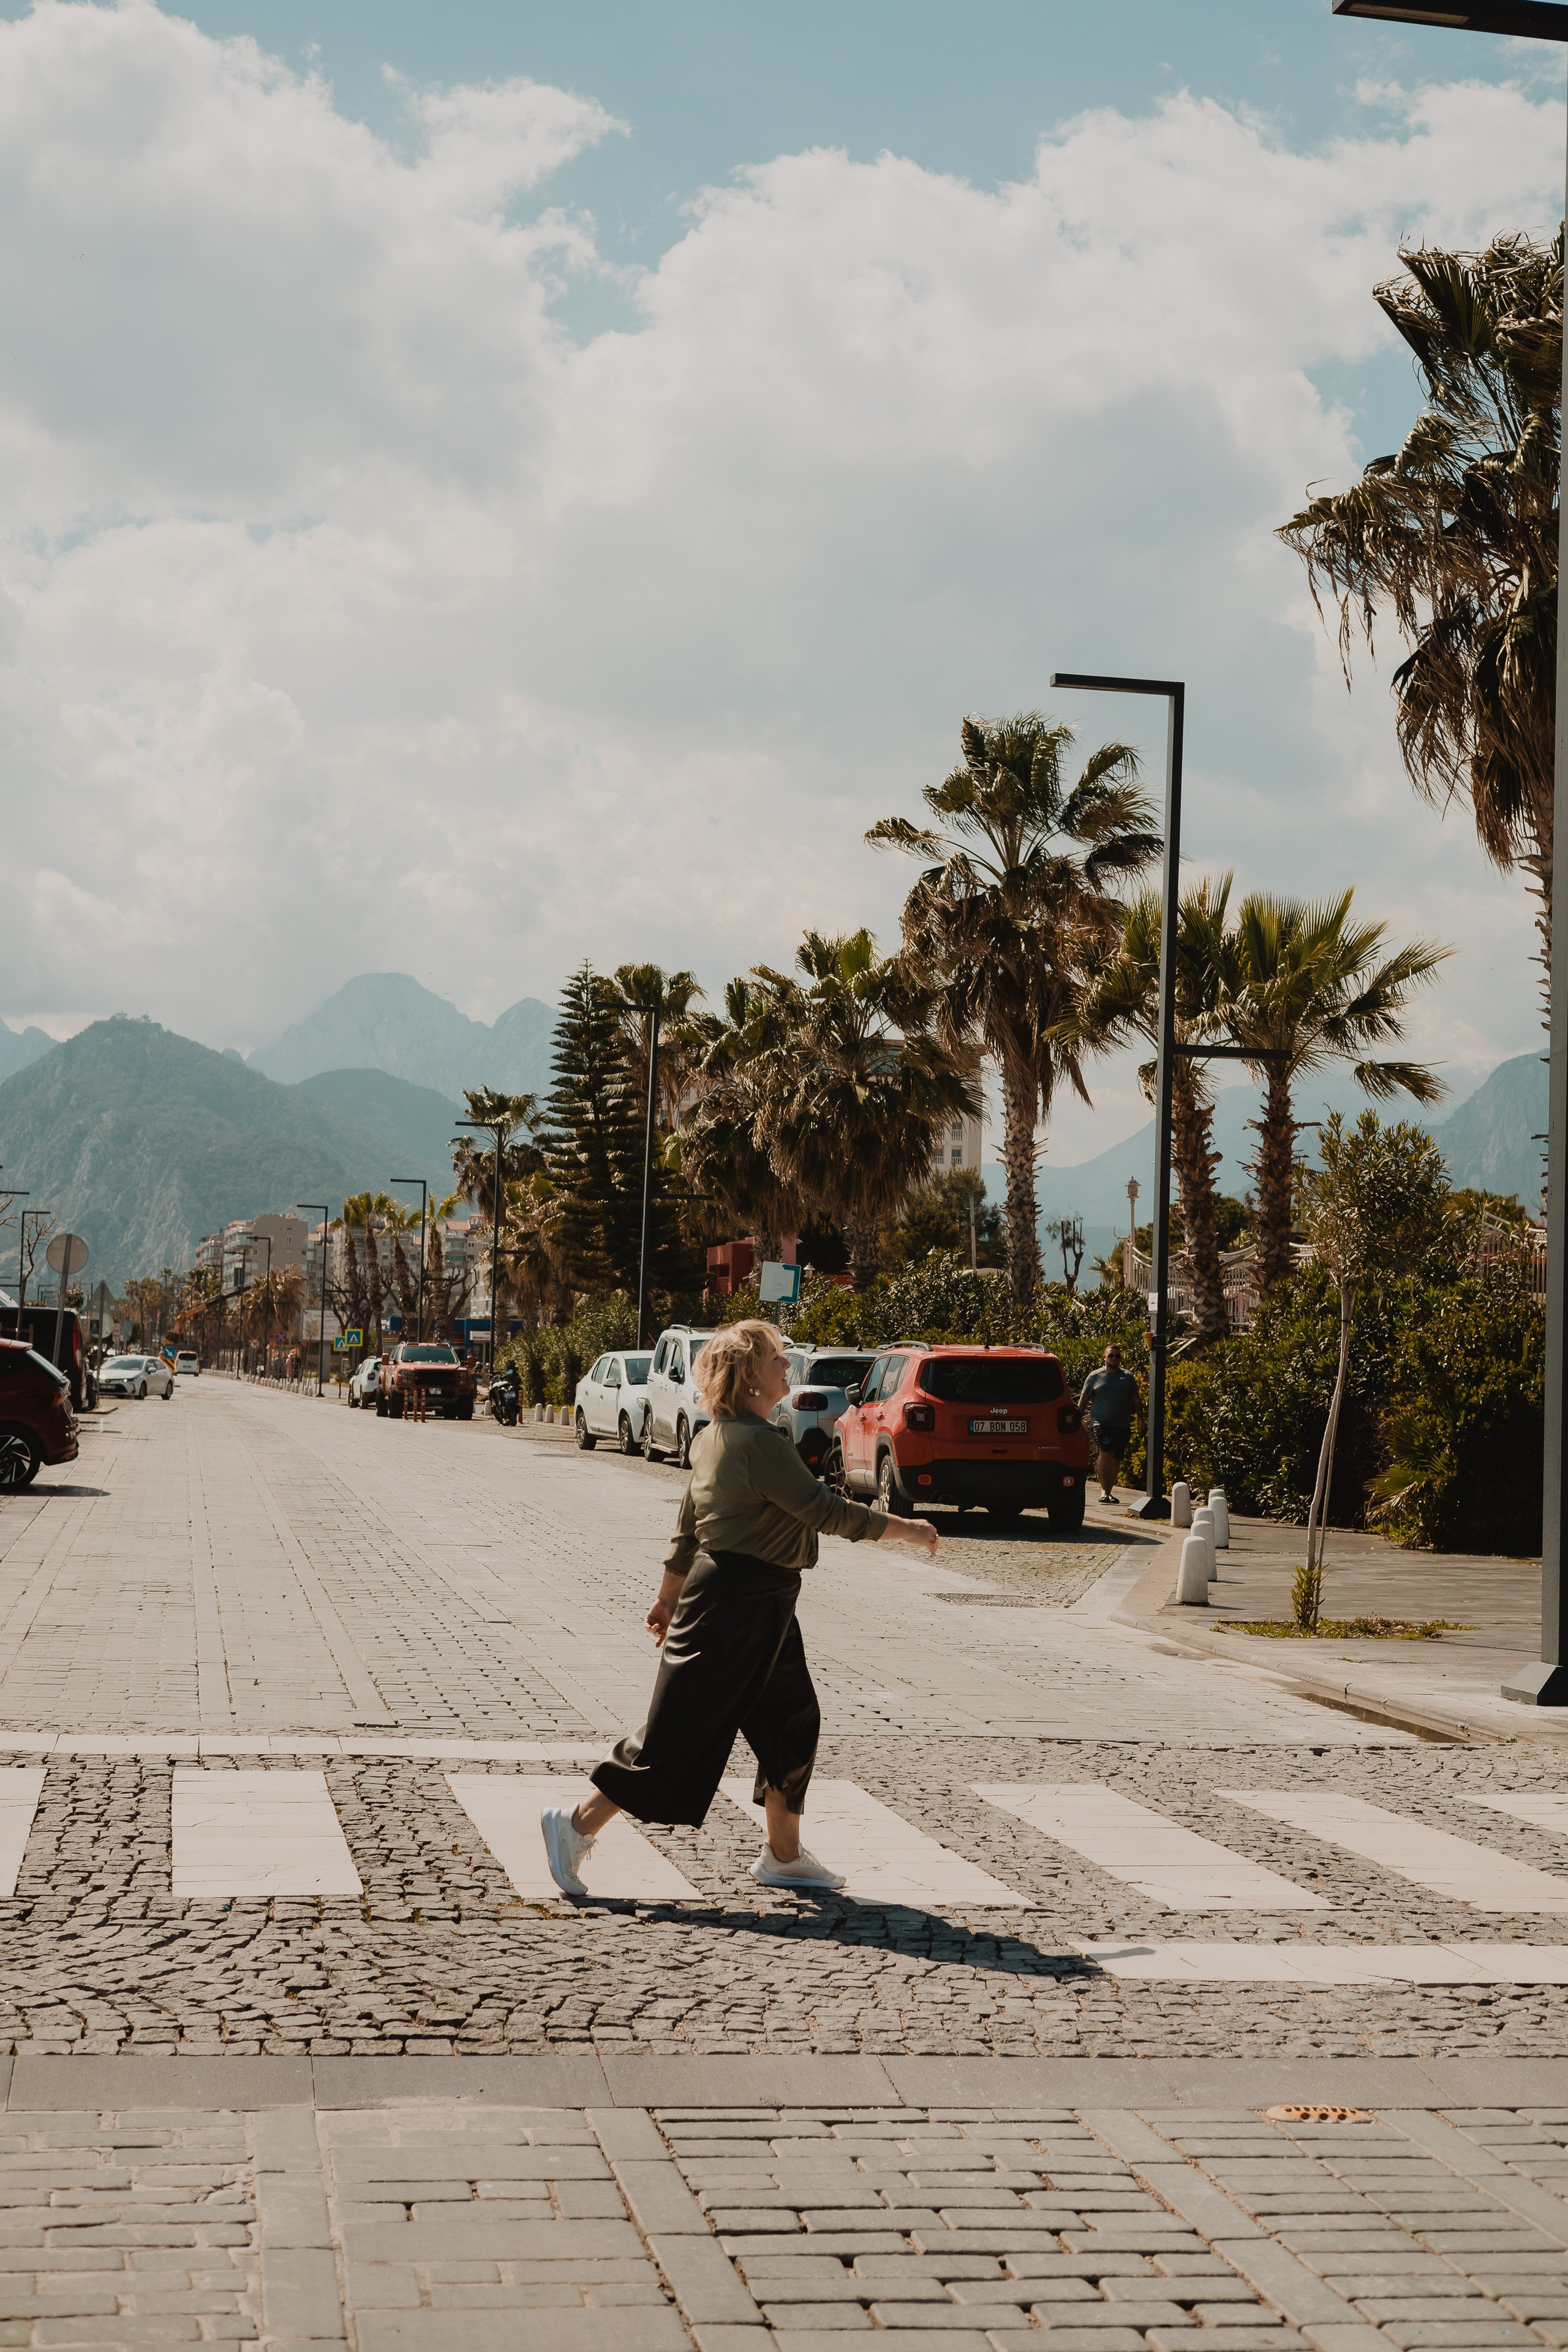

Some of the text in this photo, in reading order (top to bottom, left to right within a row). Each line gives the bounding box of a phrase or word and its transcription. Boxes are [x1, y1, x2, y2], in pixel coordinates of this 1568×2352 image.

[974, 1422, 1026, 1431] 07 BDN 058
